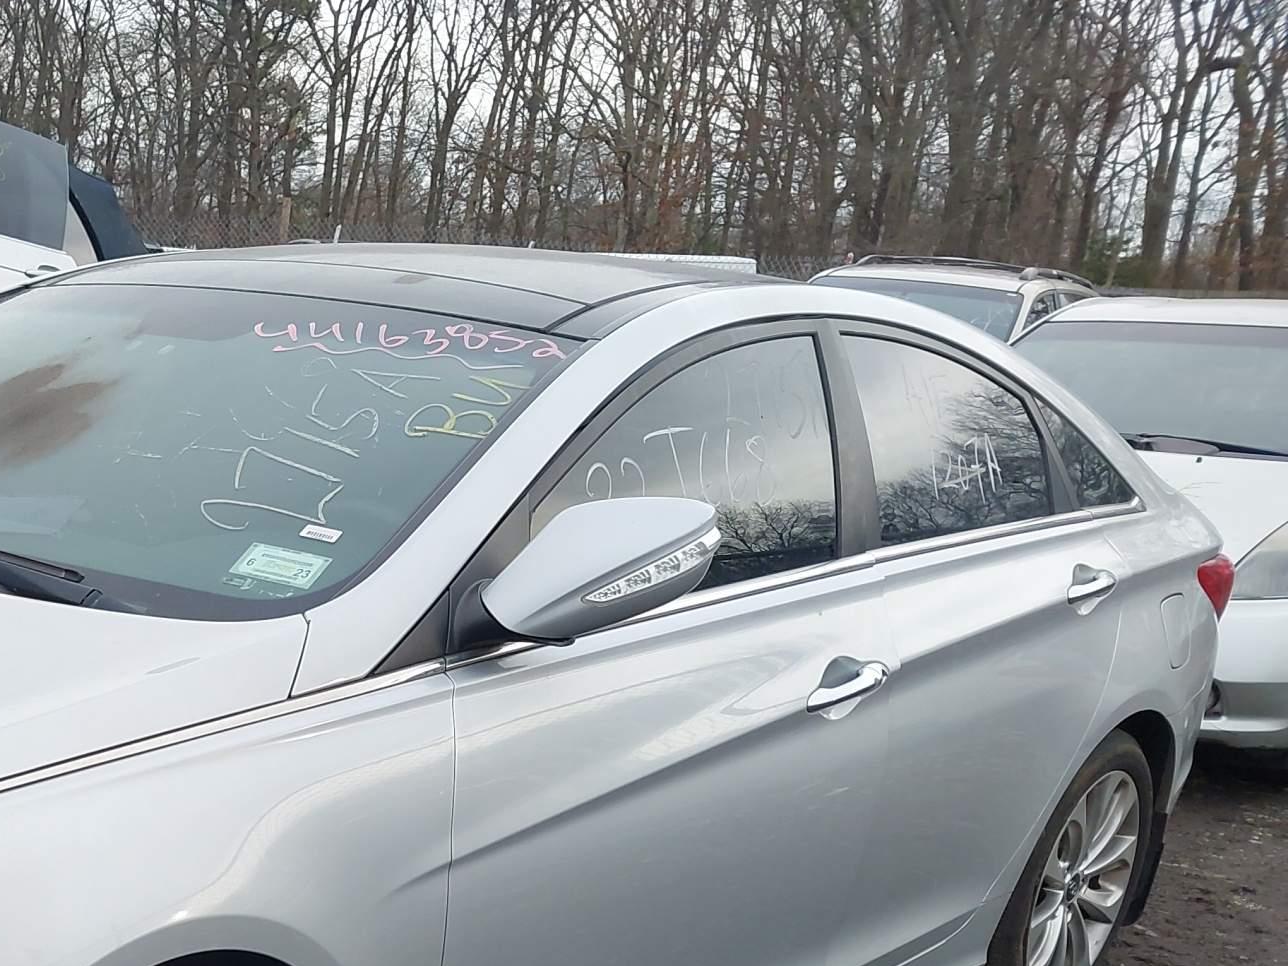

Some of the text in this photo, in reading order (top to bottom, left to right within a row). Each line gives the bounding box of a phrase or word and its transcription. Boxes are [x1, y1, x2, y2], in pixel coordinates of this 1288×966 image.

[254, 321, 567, 360] 44163852
[246, 558, 256, 567] 6
[292, 568, 312, 579] 23
